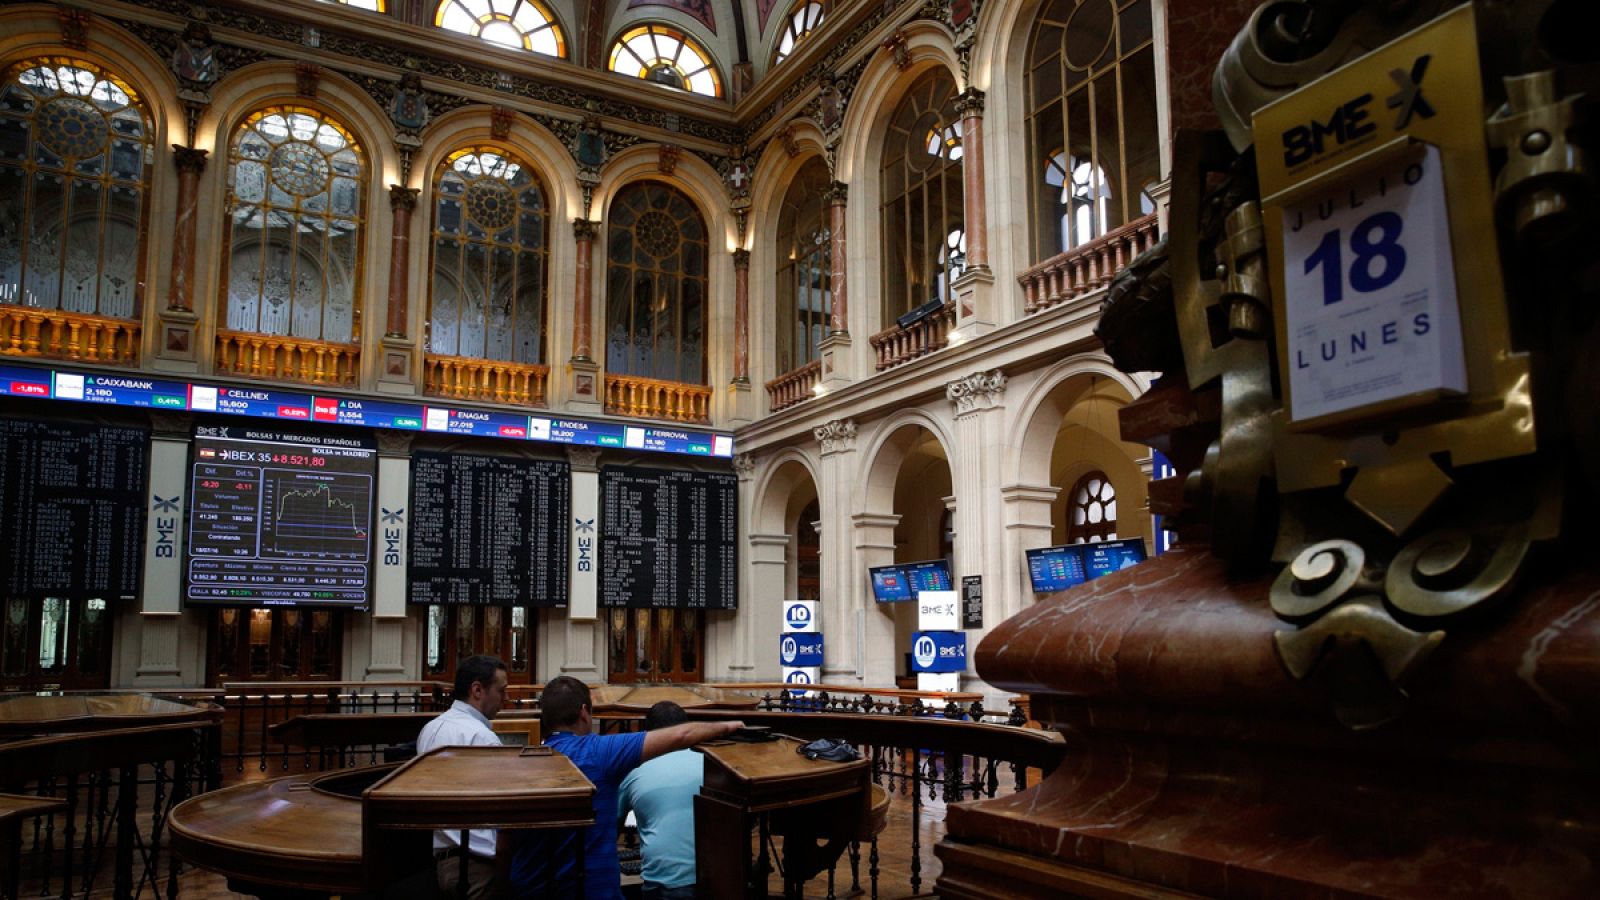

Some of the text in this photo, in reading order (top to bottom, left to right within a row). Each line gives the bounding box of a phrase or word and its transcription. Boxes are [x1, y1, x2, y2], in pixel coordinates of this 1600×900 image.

[1281, 93, 1377, 168] BME
[1292, 163, 1424, 232] JULIO
[1304, 211, 1407, 306] 18
[1297, 313, 1431, 369] LUNES
[96, 377, 152, 390] CAIXABANK
[228, 389, 269, 401] CELLNEX
[347, 401, 362, 409] DIA
[457, 411, 489, 421] ENAGAS
[197, 426, 218, 436] BME
[559, 420, 588, 430] ENDESA
[246, 431, 273, 440] BOLSAS
[282, 433, 321, 444] MERCADOS
[323, 437, 361, 447] ESPAÑOLES
[652, 430, 689, 441] FERROVIAL
[229, 450, 255, 462] IBEX
[257, 452, 271, 462] 35
[312, 447, 334, 455] BOLSA
[342, 450, 370, 458] MADRID
[156, 517, 174, 558] BME
[384, 527, 400, 566] BME
[578, 536, 591, 572] BME
[791, 607, 807, 621] 10
[784, 640, 794, 654] 10
[919, 640, 933, 656] 10
